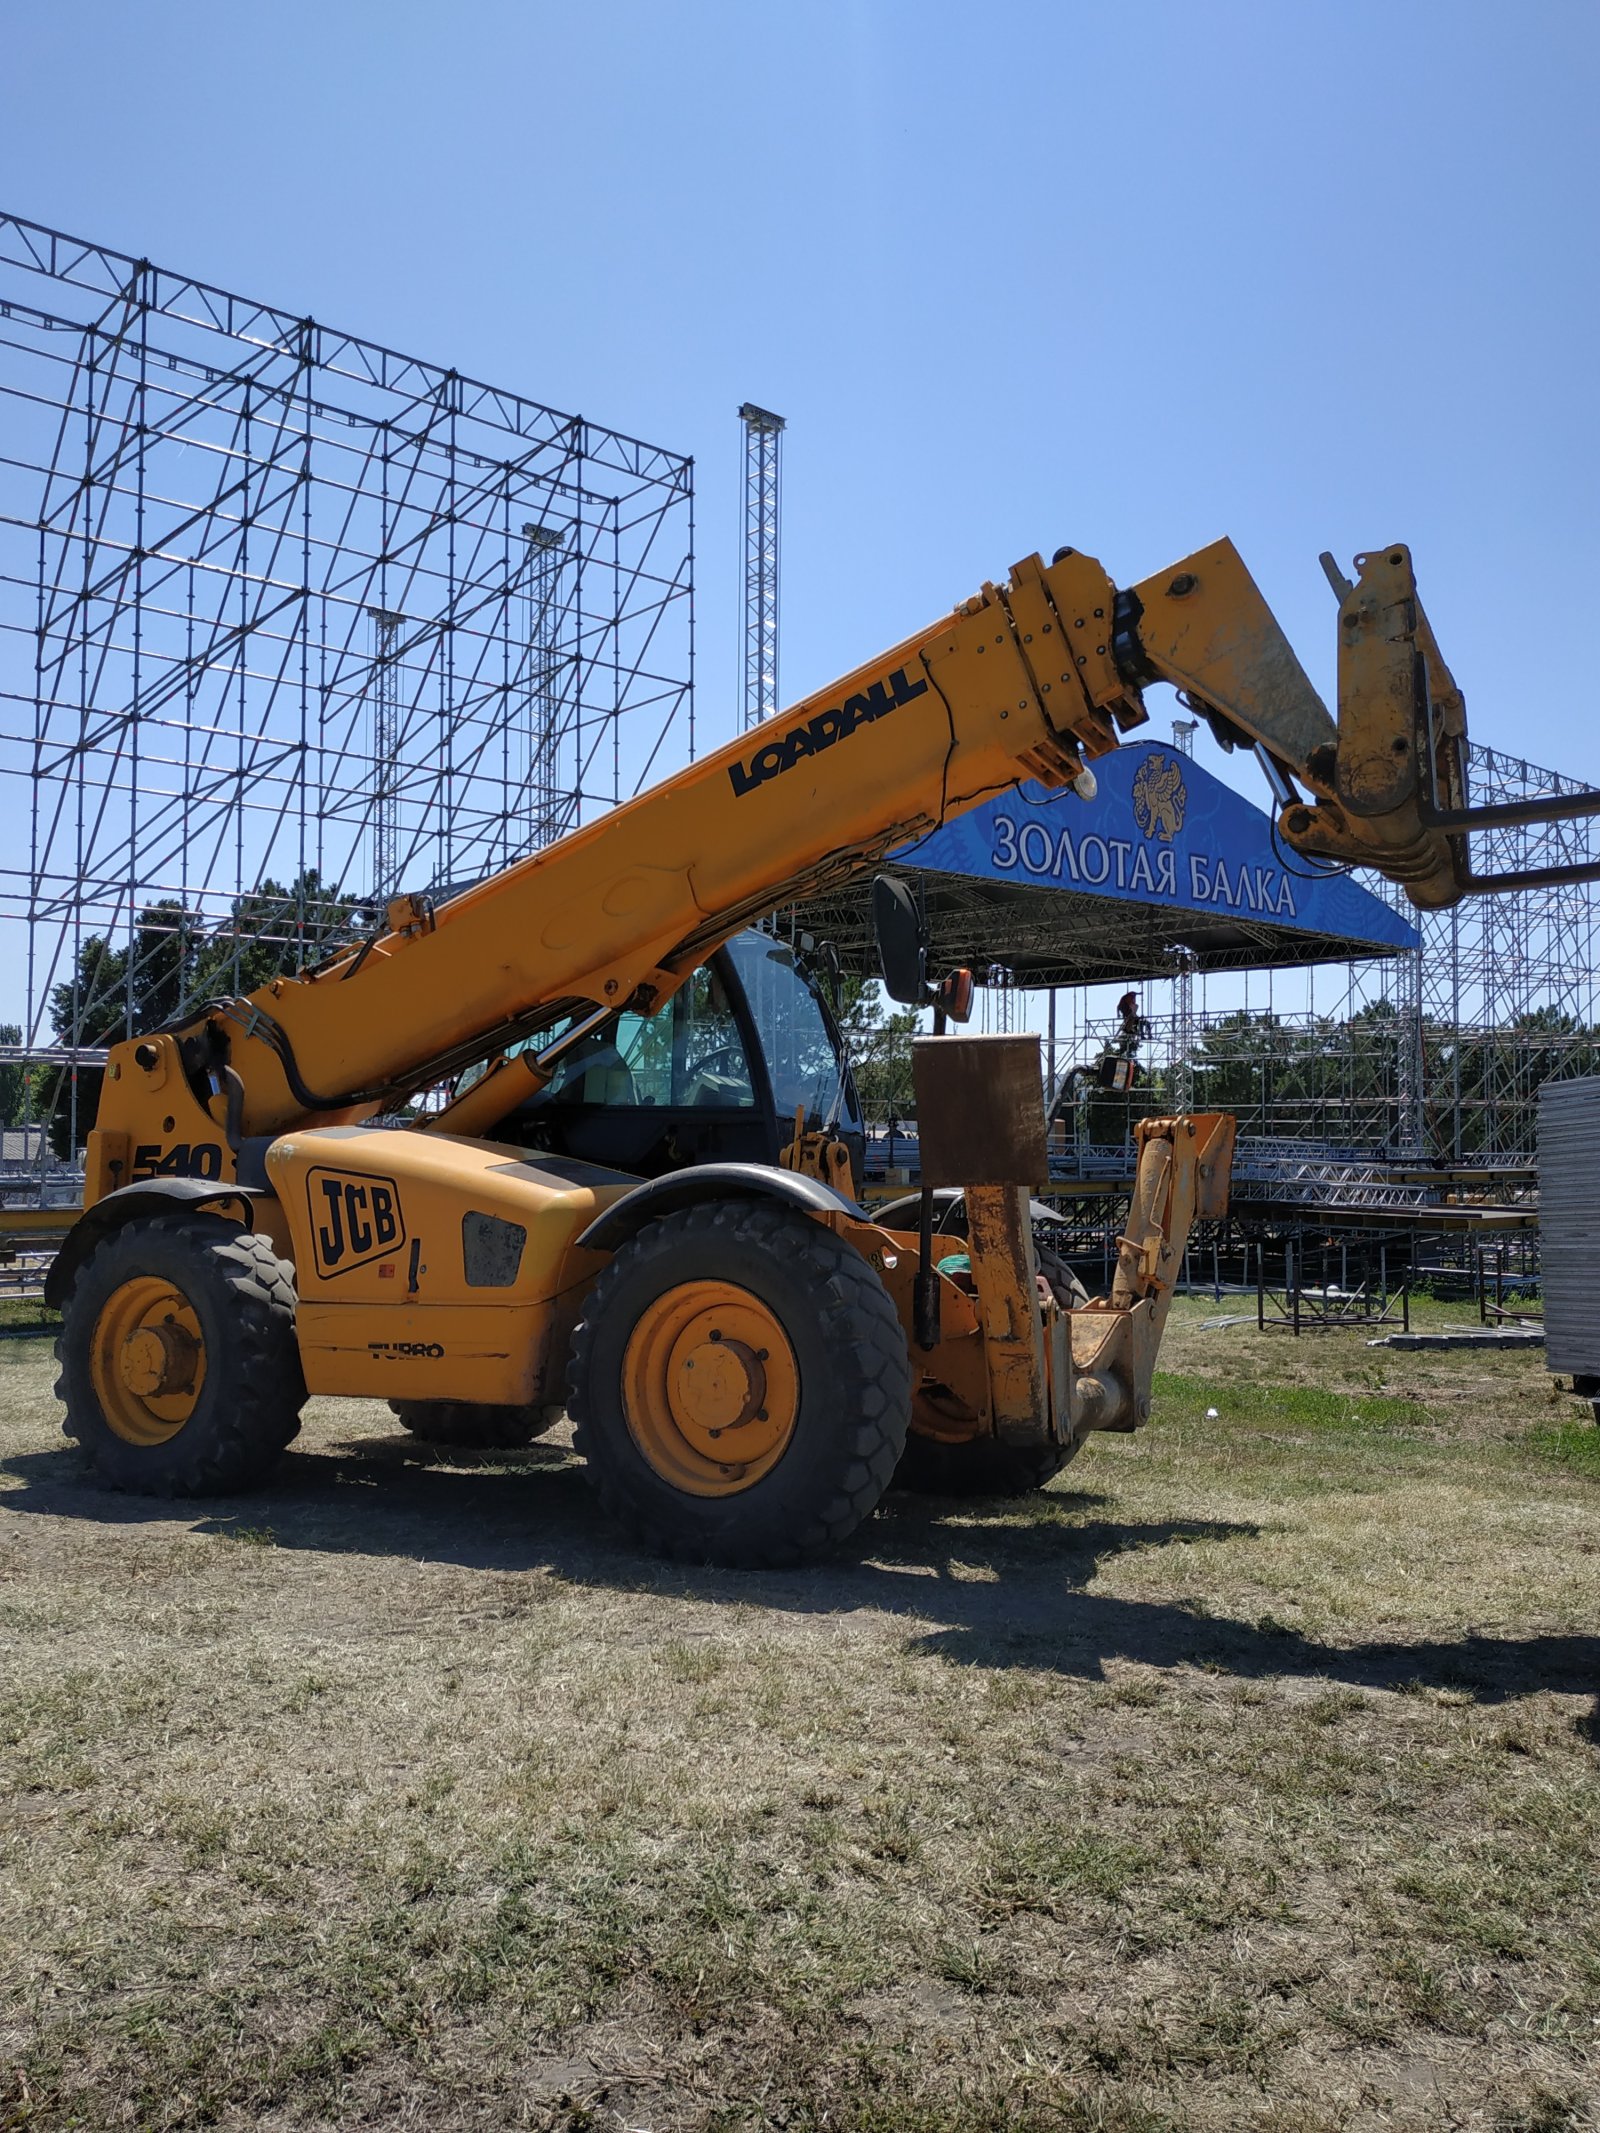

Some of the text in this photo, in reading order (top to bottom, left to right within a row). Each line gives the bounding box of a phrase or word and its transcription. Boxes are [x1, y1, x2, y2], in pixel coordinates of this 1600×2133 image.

[728, 668, 928, 798] LOADALL
[992, 816, 1297, 917] ЗОЛОТАЯ БАЛКА
[132, 1143, 223, 1182] 540
[319, 1179, 397, 1266] JCB
